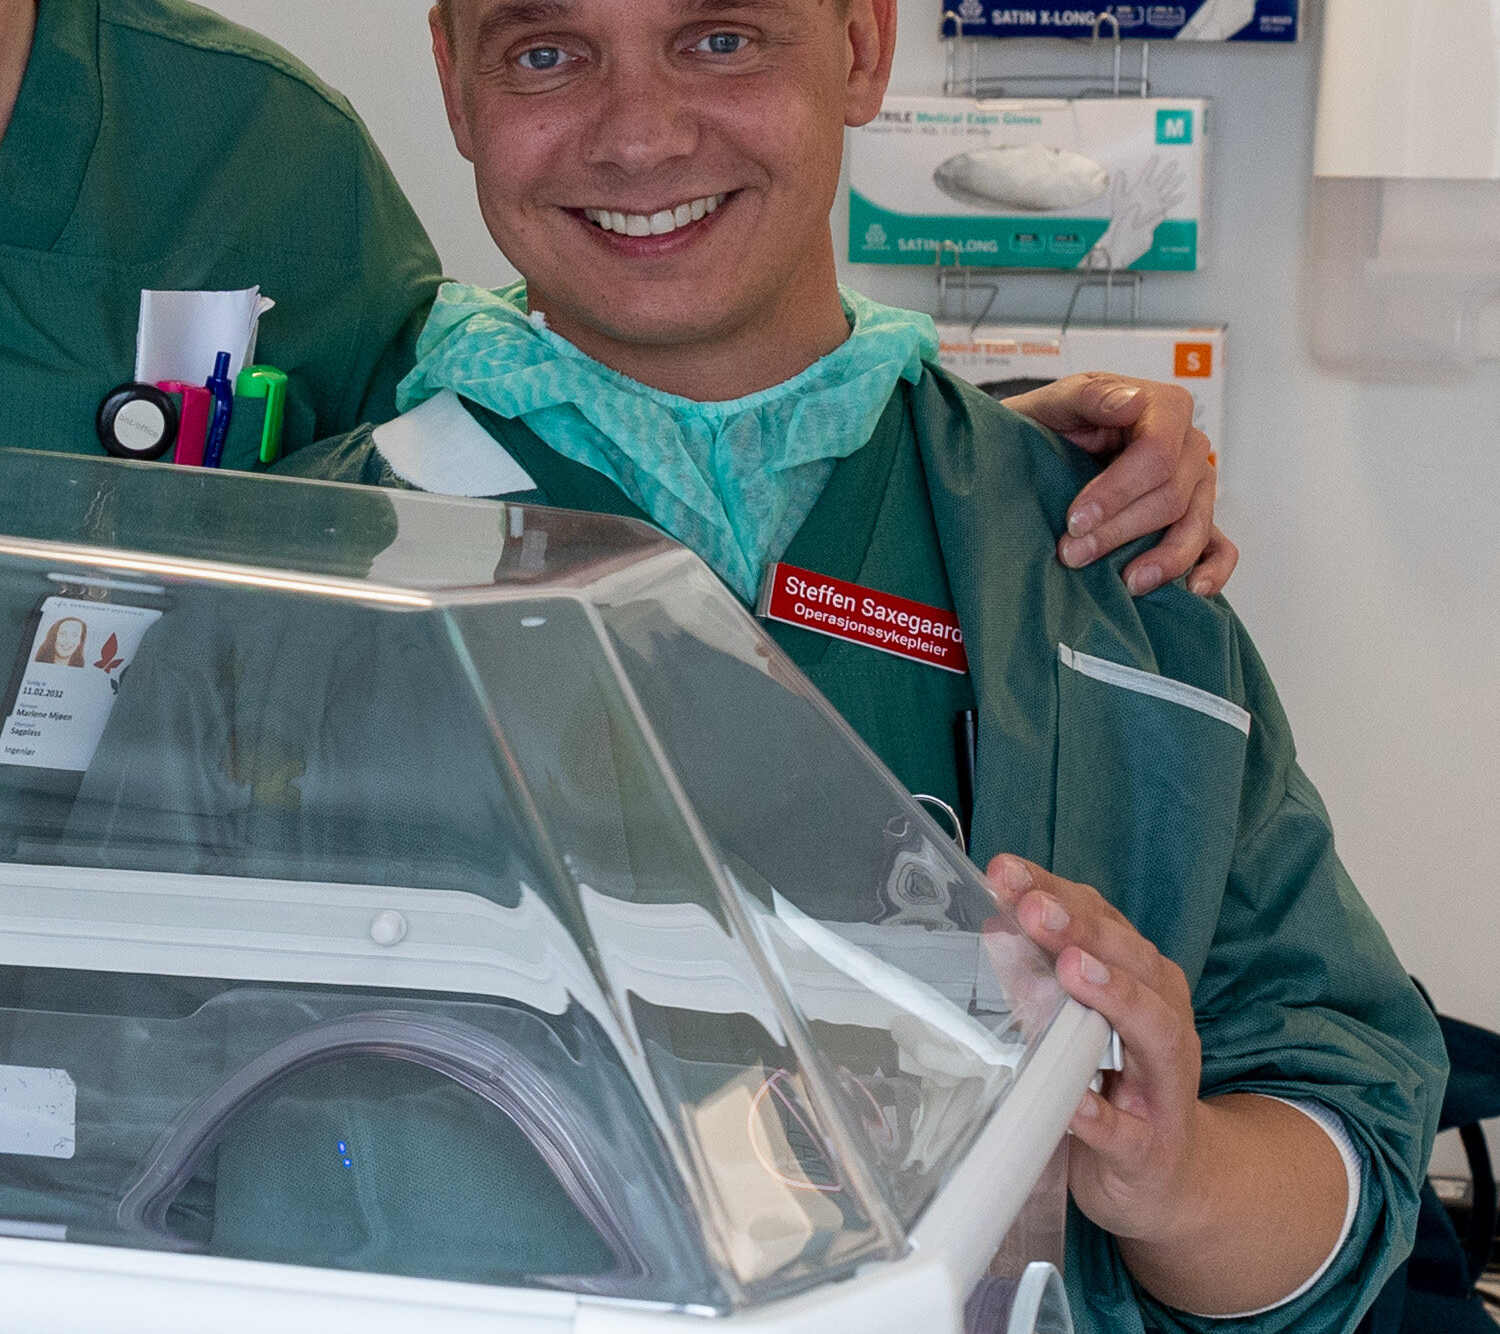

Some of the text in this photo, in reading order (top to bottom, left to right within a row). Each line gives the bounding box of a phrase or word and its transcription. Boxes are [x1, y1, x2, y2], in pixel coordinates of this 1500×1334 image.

[992, 10, 1096, 25] SATIN X-LONG
[875, 111, 1042, 126] TRILE Medical Exam Gloves
[1165, 118, 1185, 138] M
[898, 238, 936, 253] SATIN
[1186, 352, 1201, 371] S
[784, 575, 856, 614] Steffen
[794, 602, 948, 658] Operasjonssykepleier
[22, 686, 64, 699] 11.02.2032
[16, 708, 73, 722] Marlene Mjøen
[10, 726, 42, 739] Sagplass
[4, 746, 36, 758] Ingeniør
